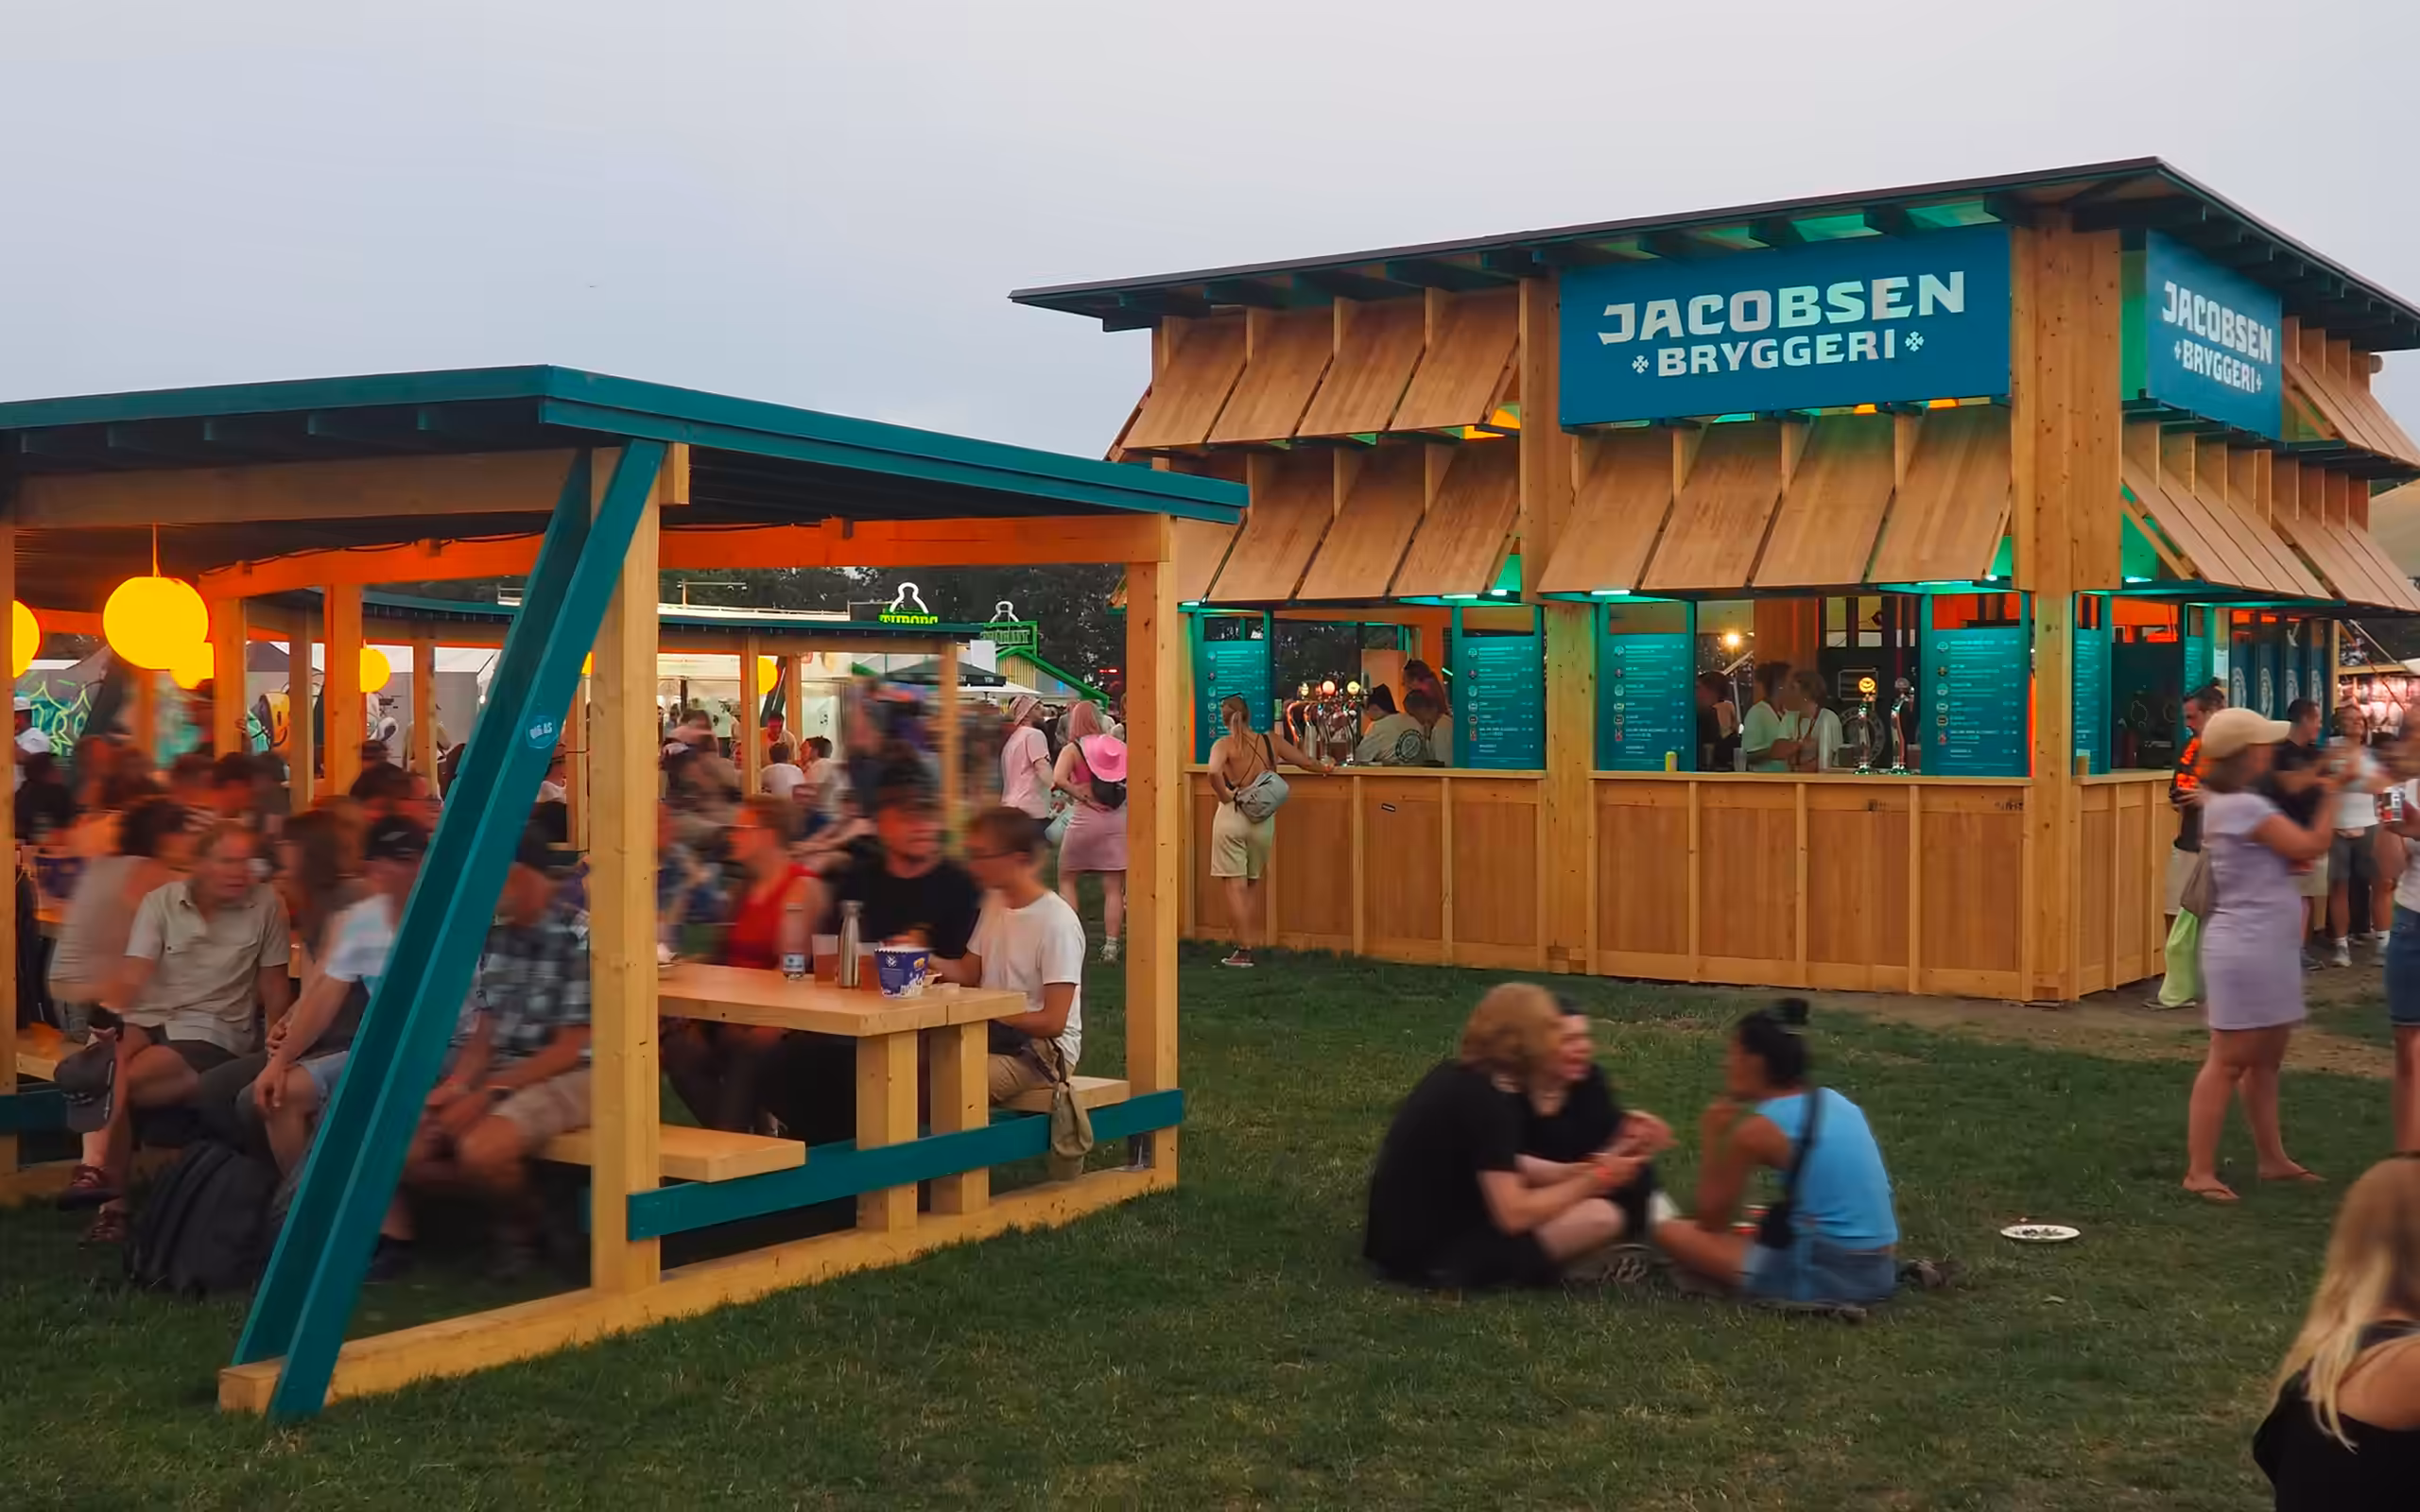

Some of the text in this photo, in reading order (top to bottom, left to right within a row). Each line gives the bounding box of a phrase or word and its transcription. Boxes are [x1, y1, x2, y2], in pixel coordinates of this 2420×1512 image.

[1598, 270, 1964, 345] JACOBSEN
[2162, 281, 2273, 365] JACOBSEN
[1657, 328, 1895, 377] BRYGGERI
[2182, 338, 2256, 394] BRYGGERI
